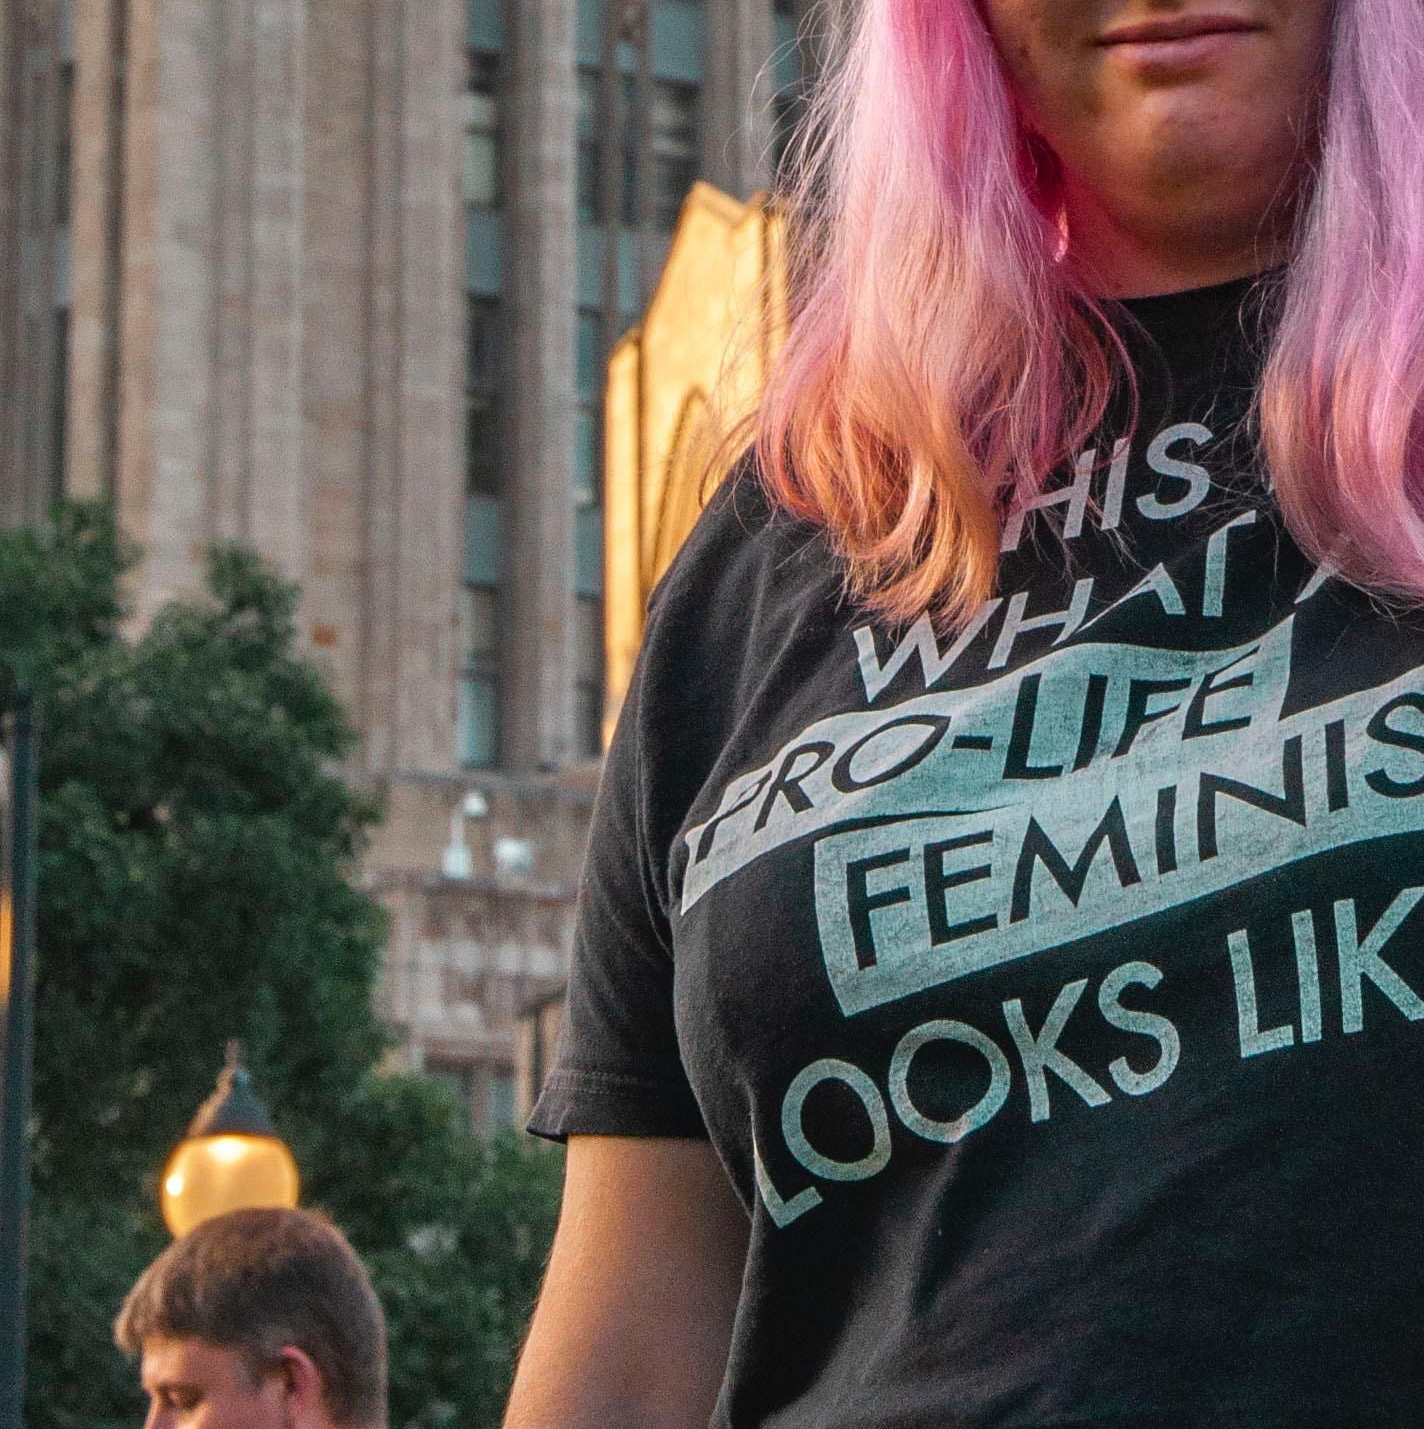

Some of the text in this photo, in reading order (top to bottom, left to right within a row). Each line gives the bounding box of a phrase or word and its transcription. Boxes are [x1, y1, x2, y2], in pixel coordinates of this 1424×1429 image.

[1000, 421, 1214, 553] HIS
[694, 644, 1262, 865] PRO-LIFE
[751, 960, 1181, 1229] LOOKS
